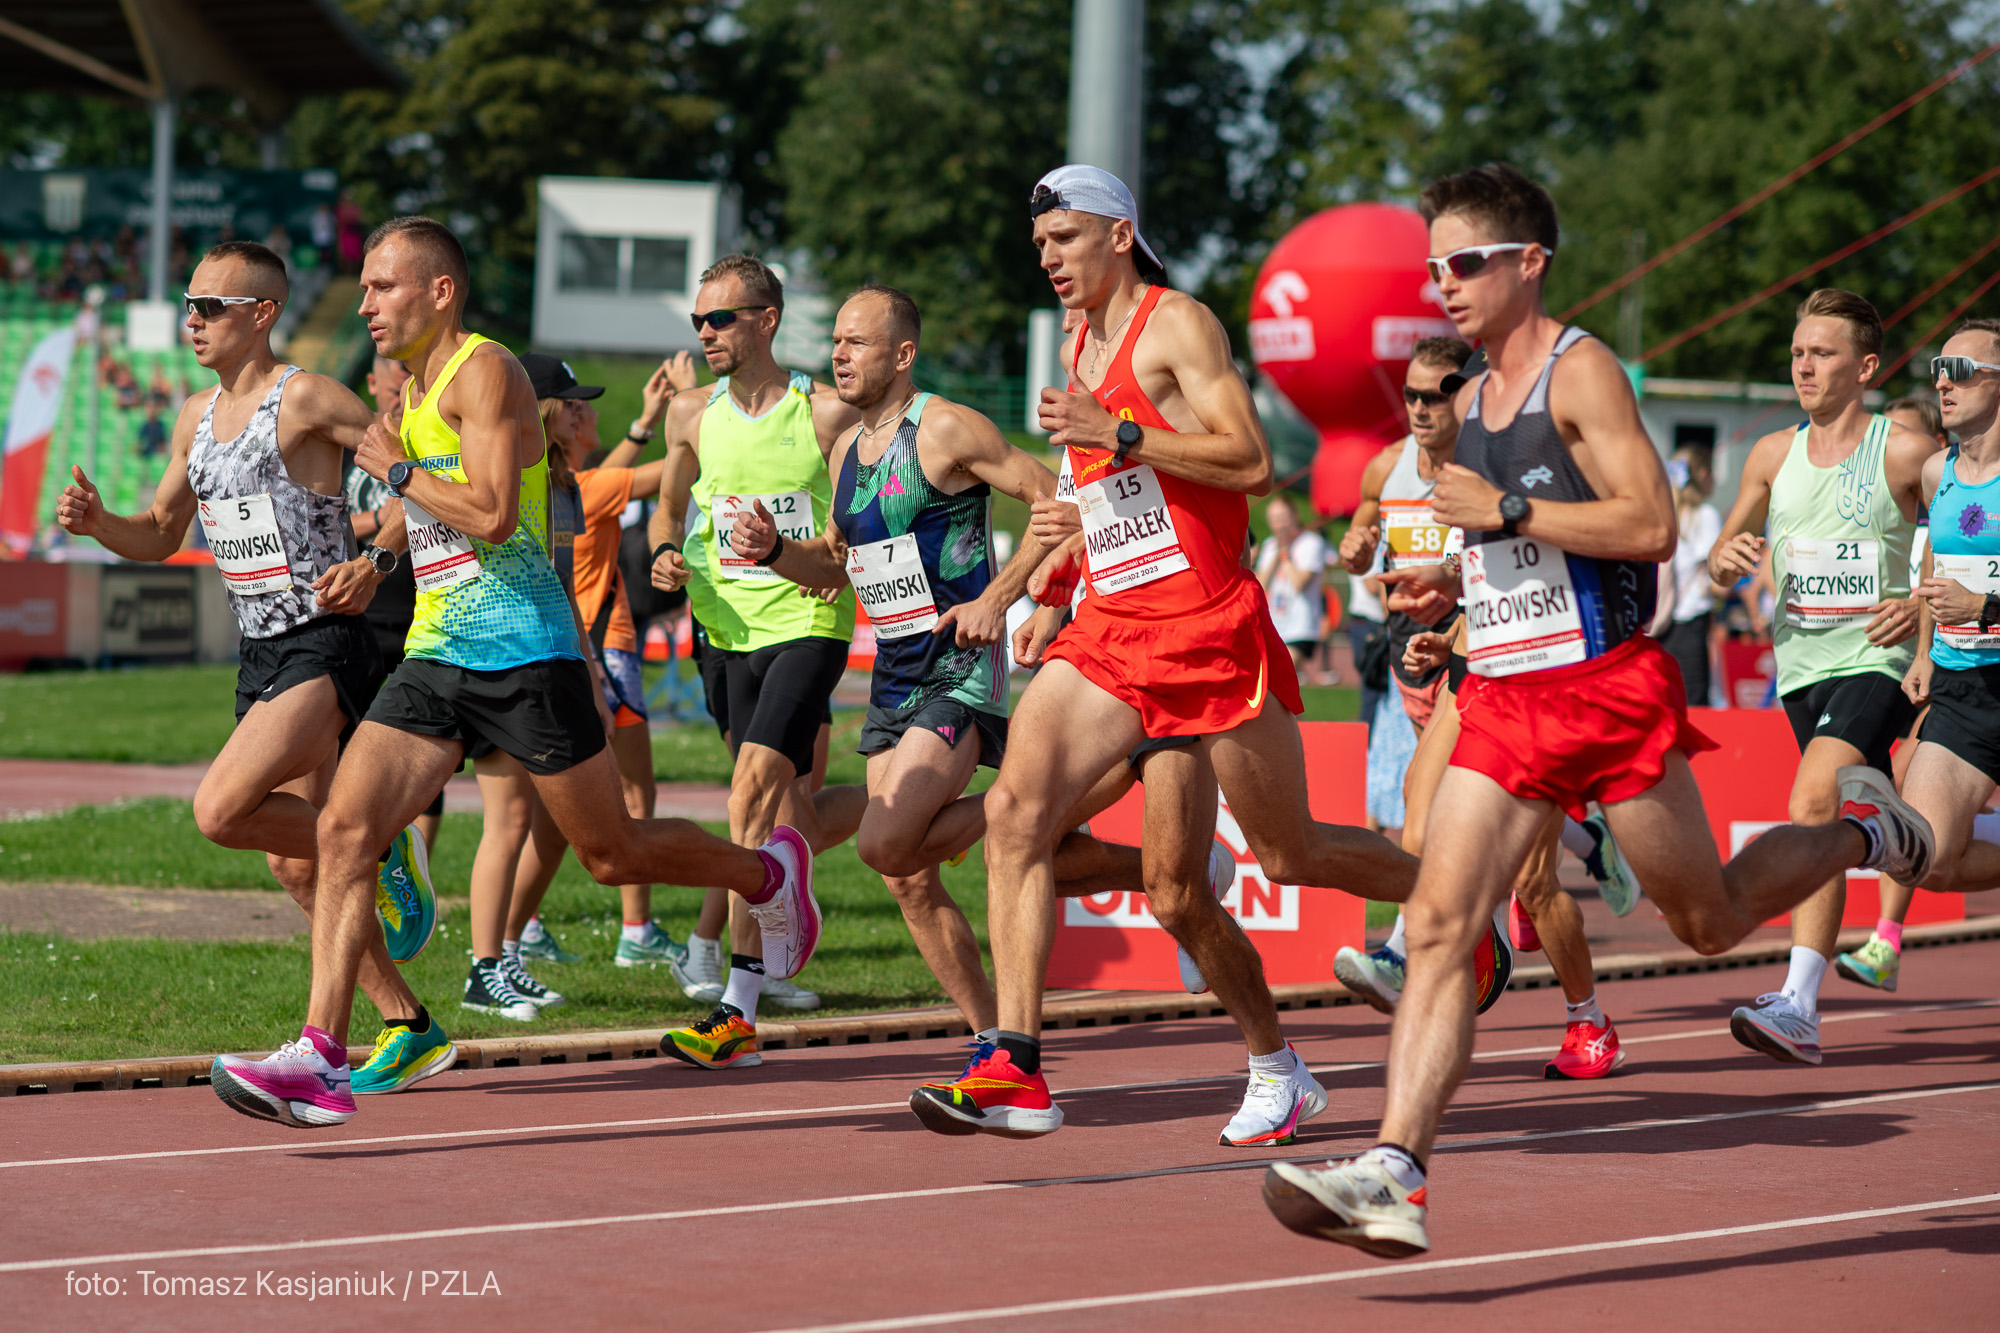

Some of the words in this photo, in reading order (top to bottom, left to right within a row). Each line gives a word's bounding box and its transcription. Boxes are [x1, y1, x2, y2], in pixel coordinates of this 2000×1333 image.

[1114, 473, 1142, 500] 15
[238, 502, 251, 521] 5
[771, 496, 796, 514] 12
[1087, 507, 1171, 558] MARSZAŁEK
[1411, 528, 1441, 552] 58
[882, 543, 894, 563] 7
[1512, 542, 1540, 570] 10
[1836, 543, 1861, 560] 21
[443, 569, 458, 580] 2023
[1140, 565, 1159, 577] 2023
[251, 581, 267, 589] 2023
[1787, 571, 1874, 595] POŁCZYŃSKI
[391, 866, 420, 916] HOKA
